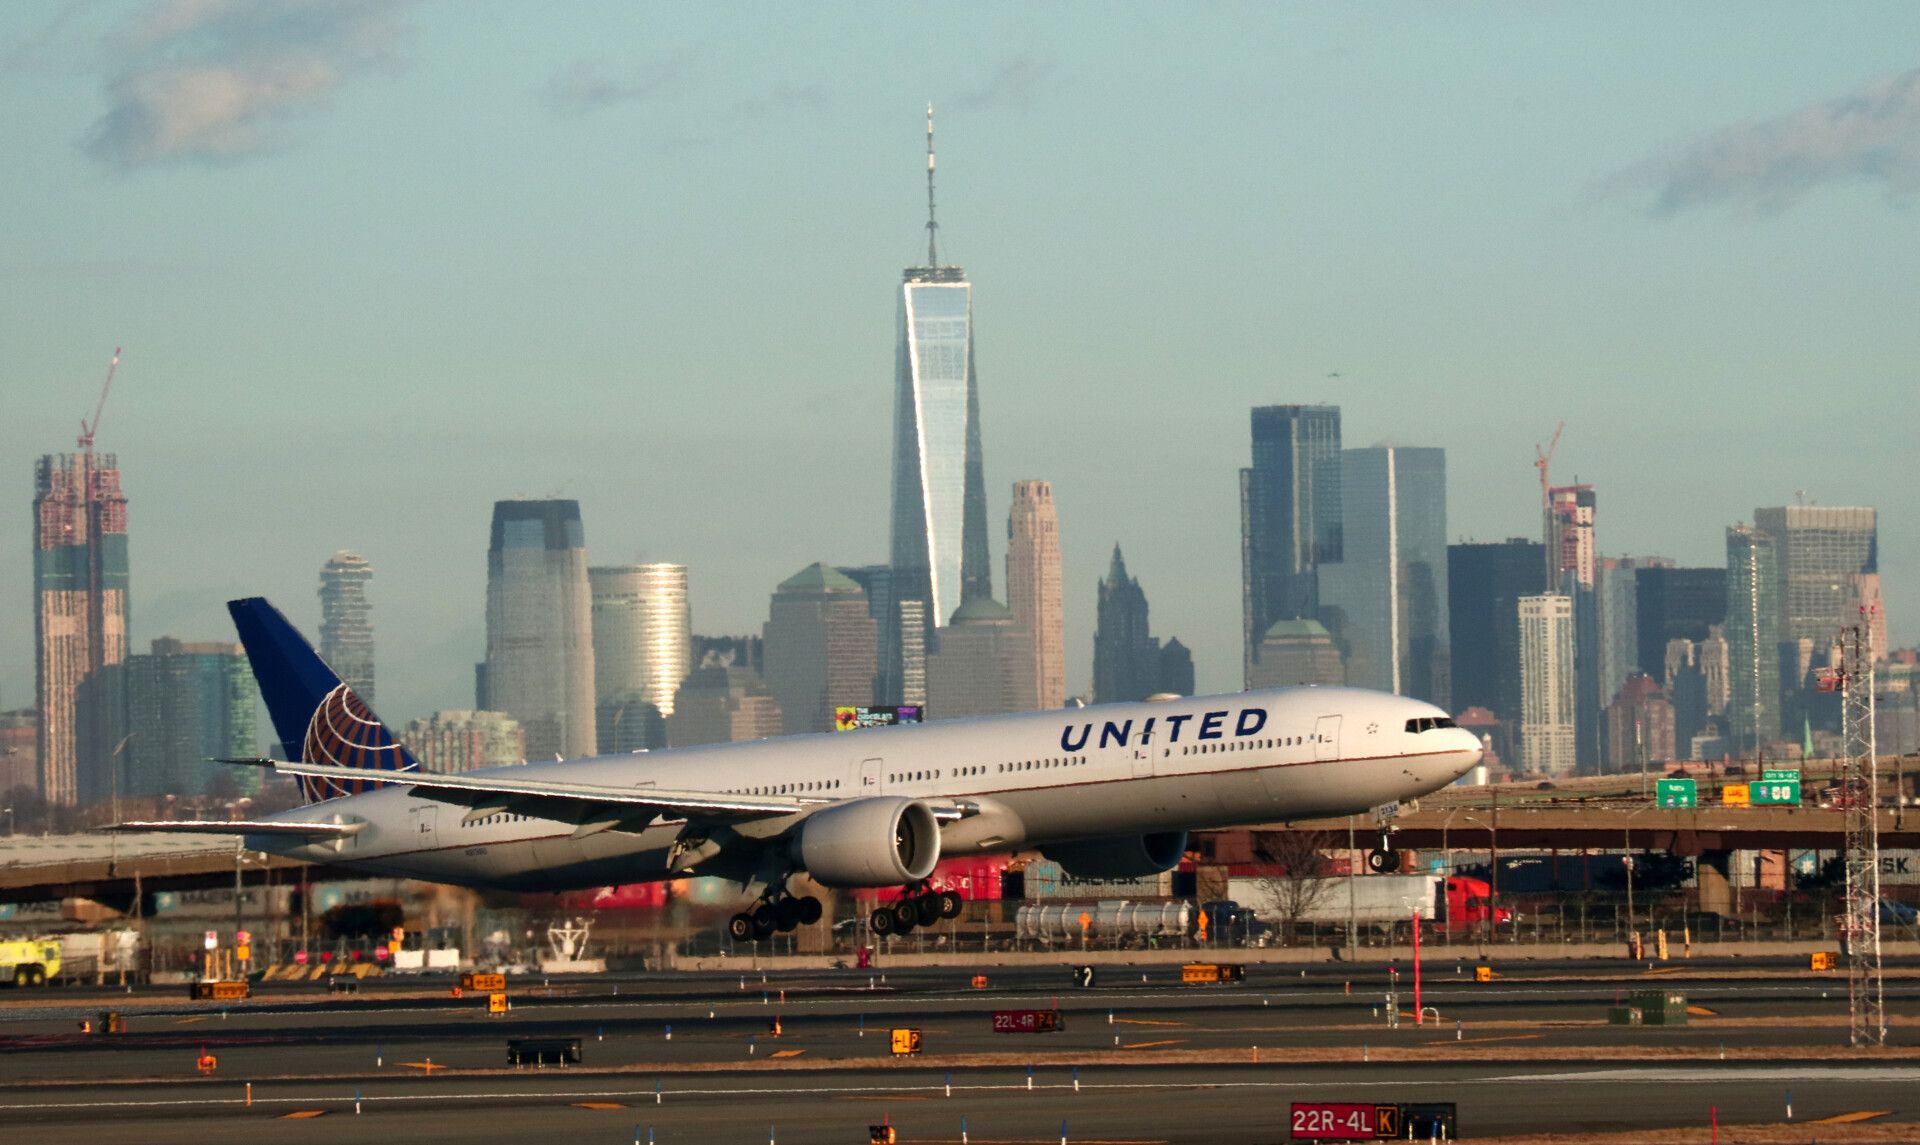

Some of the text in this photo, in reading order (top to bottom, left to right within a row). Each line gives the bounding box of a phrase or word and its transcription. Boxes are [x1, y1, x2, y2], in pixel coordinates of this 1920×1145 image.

[1061, 708, 1267, 751] UNITED
[995, 1014, 1034, 1028] 22L-4R
[912, 1033, 918, 1048] P
[1293, 1110, 1392, 1132] 22R-4L K
